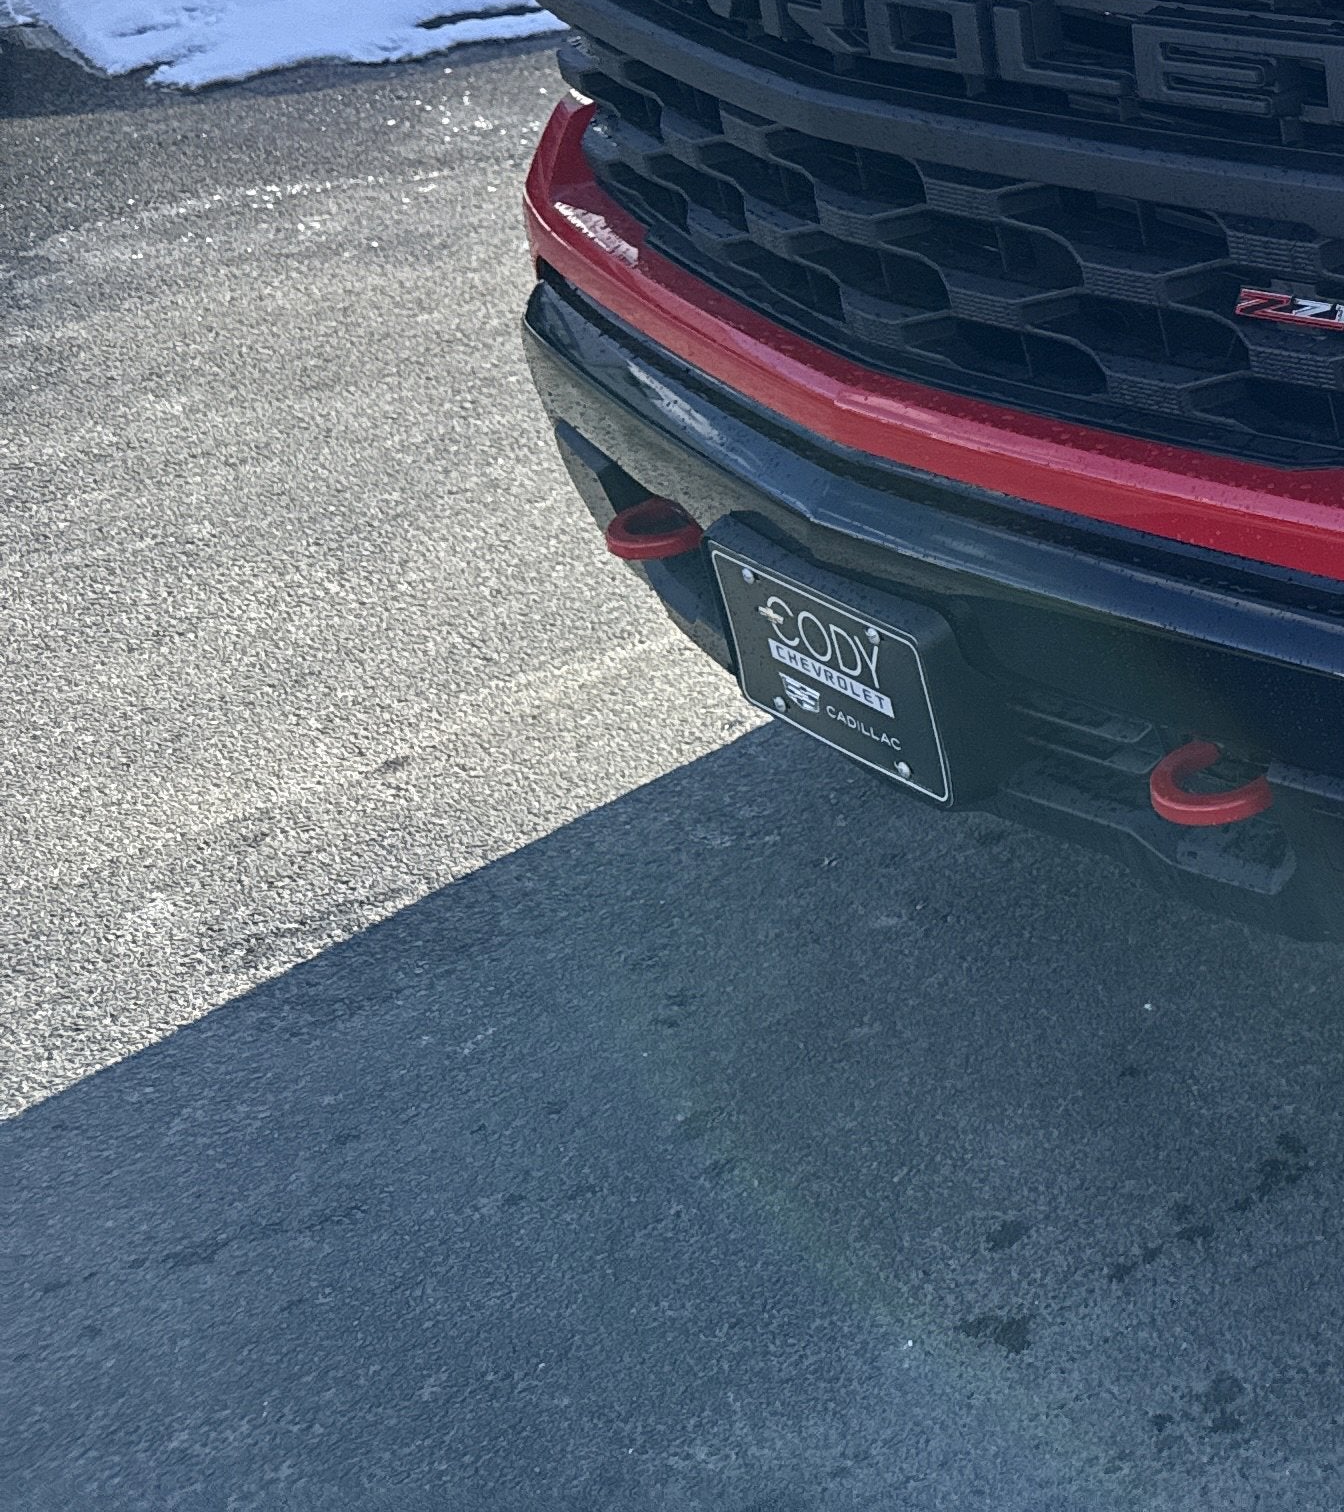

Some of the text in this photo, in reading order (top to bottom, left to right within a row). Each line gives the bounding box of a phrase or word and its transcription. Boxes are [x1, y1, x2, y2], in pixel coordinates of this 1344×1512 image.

[767, 595, 880, 690] CODY
[774, 643, 888, 712] CHEVROLET
[826, 704, 902, 751] CADILLAC
